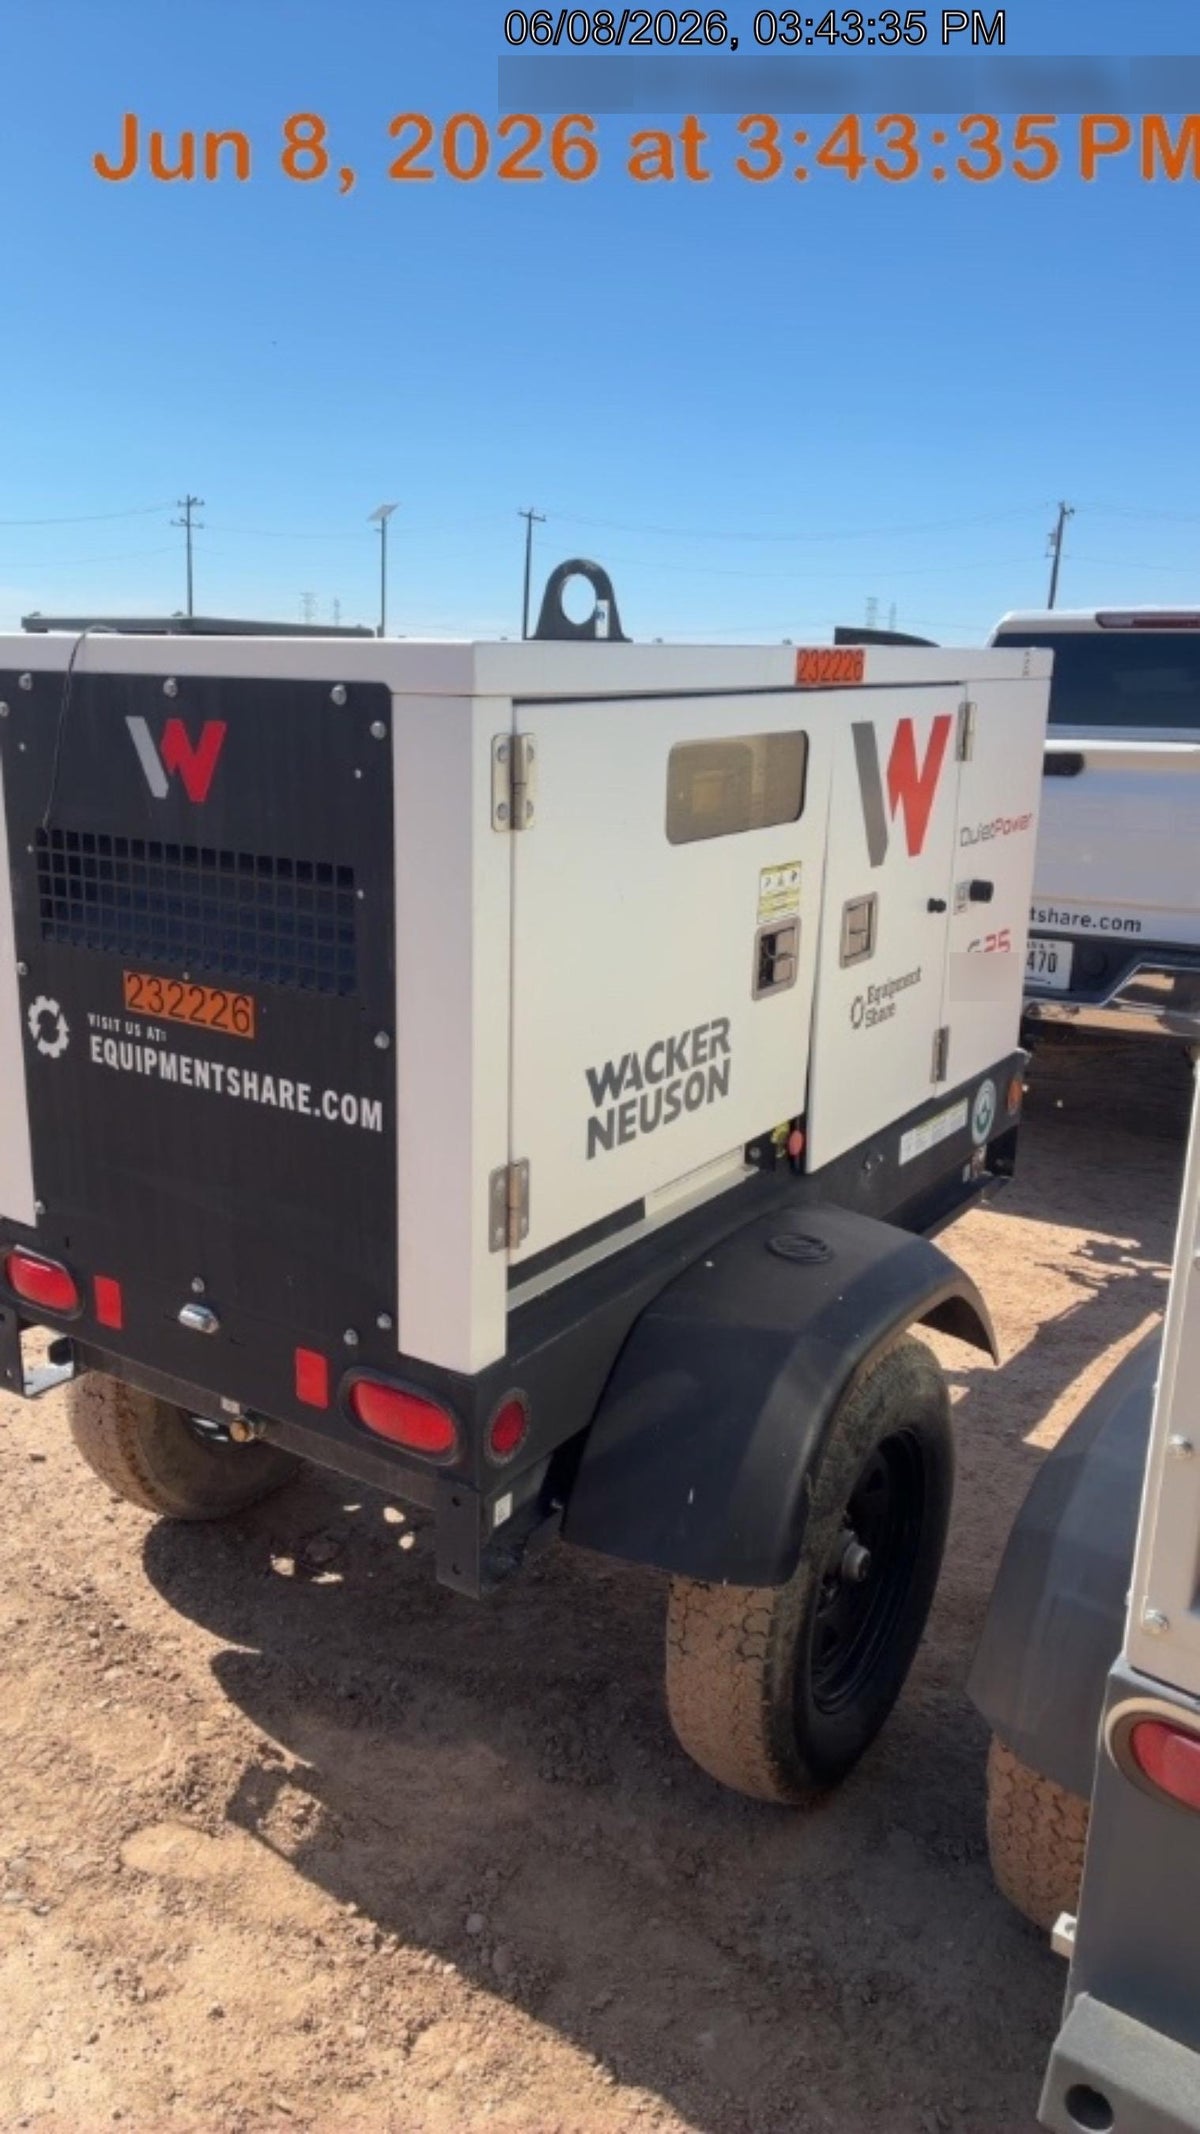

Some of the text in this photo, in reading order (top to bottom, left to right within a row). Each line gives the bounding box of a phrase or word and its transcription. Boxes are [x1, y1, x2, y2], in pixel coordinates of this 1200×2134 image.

[797, 648, 864, 683] 232226
[960, 813, 1033, 847] QuietPower
[1029, 906, 1142, 932] tshare.com
[126, 972, 252, 1034] 232226
[867, 966, 922, 1006] Equipment
[87, 1012, 121, 1033] VISIT
[125, 1022, 141, 1038] US
[865, 1002, 897, 1029] Share
[585, 1016, 731, 1108] WACKER
[89, 1034, 383, 1132] EQUIPMENTSHARE.COM
[585, 1057, 731, 1161] NEUSON
